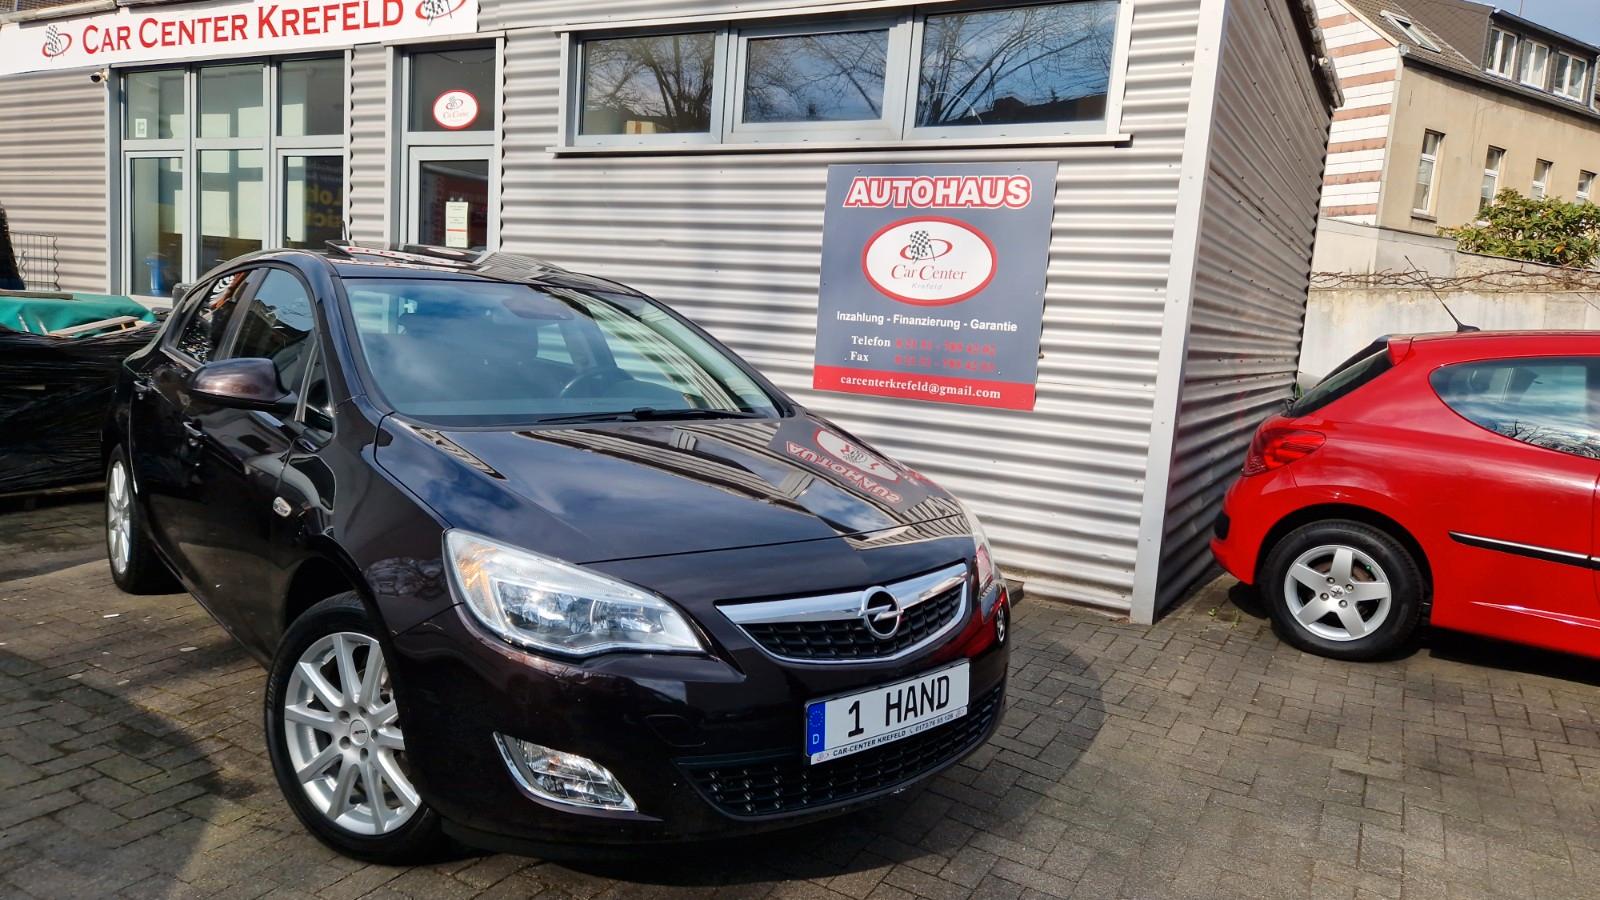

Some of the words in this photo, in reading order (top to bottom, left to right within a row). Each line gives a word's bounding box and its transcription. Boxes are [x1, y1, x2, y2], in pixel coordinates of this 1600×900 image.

[843, 175, 1033, 209] AUTOHAUS
[891, 264, 917, 280] Car
[919, 265, 967, 281] Center
[837, 311, 884, 325] Inzahlung
[893, 315, 961, 329] Finanzierung
[970, 319, 1018, 332] Garantie
[851, 335, 891, 348] Telefon
[850, 351, 869, 362] Fax
[840, 375, 1001, 399] carcenterkrefeld@gmail.com
[848, 700, 865, 738] 1
[885, 675, 950, 726] HAND
[812, 733, 820, 745] D
[833, 740, 876, 757] CAR-CENTER
[878, 731, 906, 744] KREFELD
